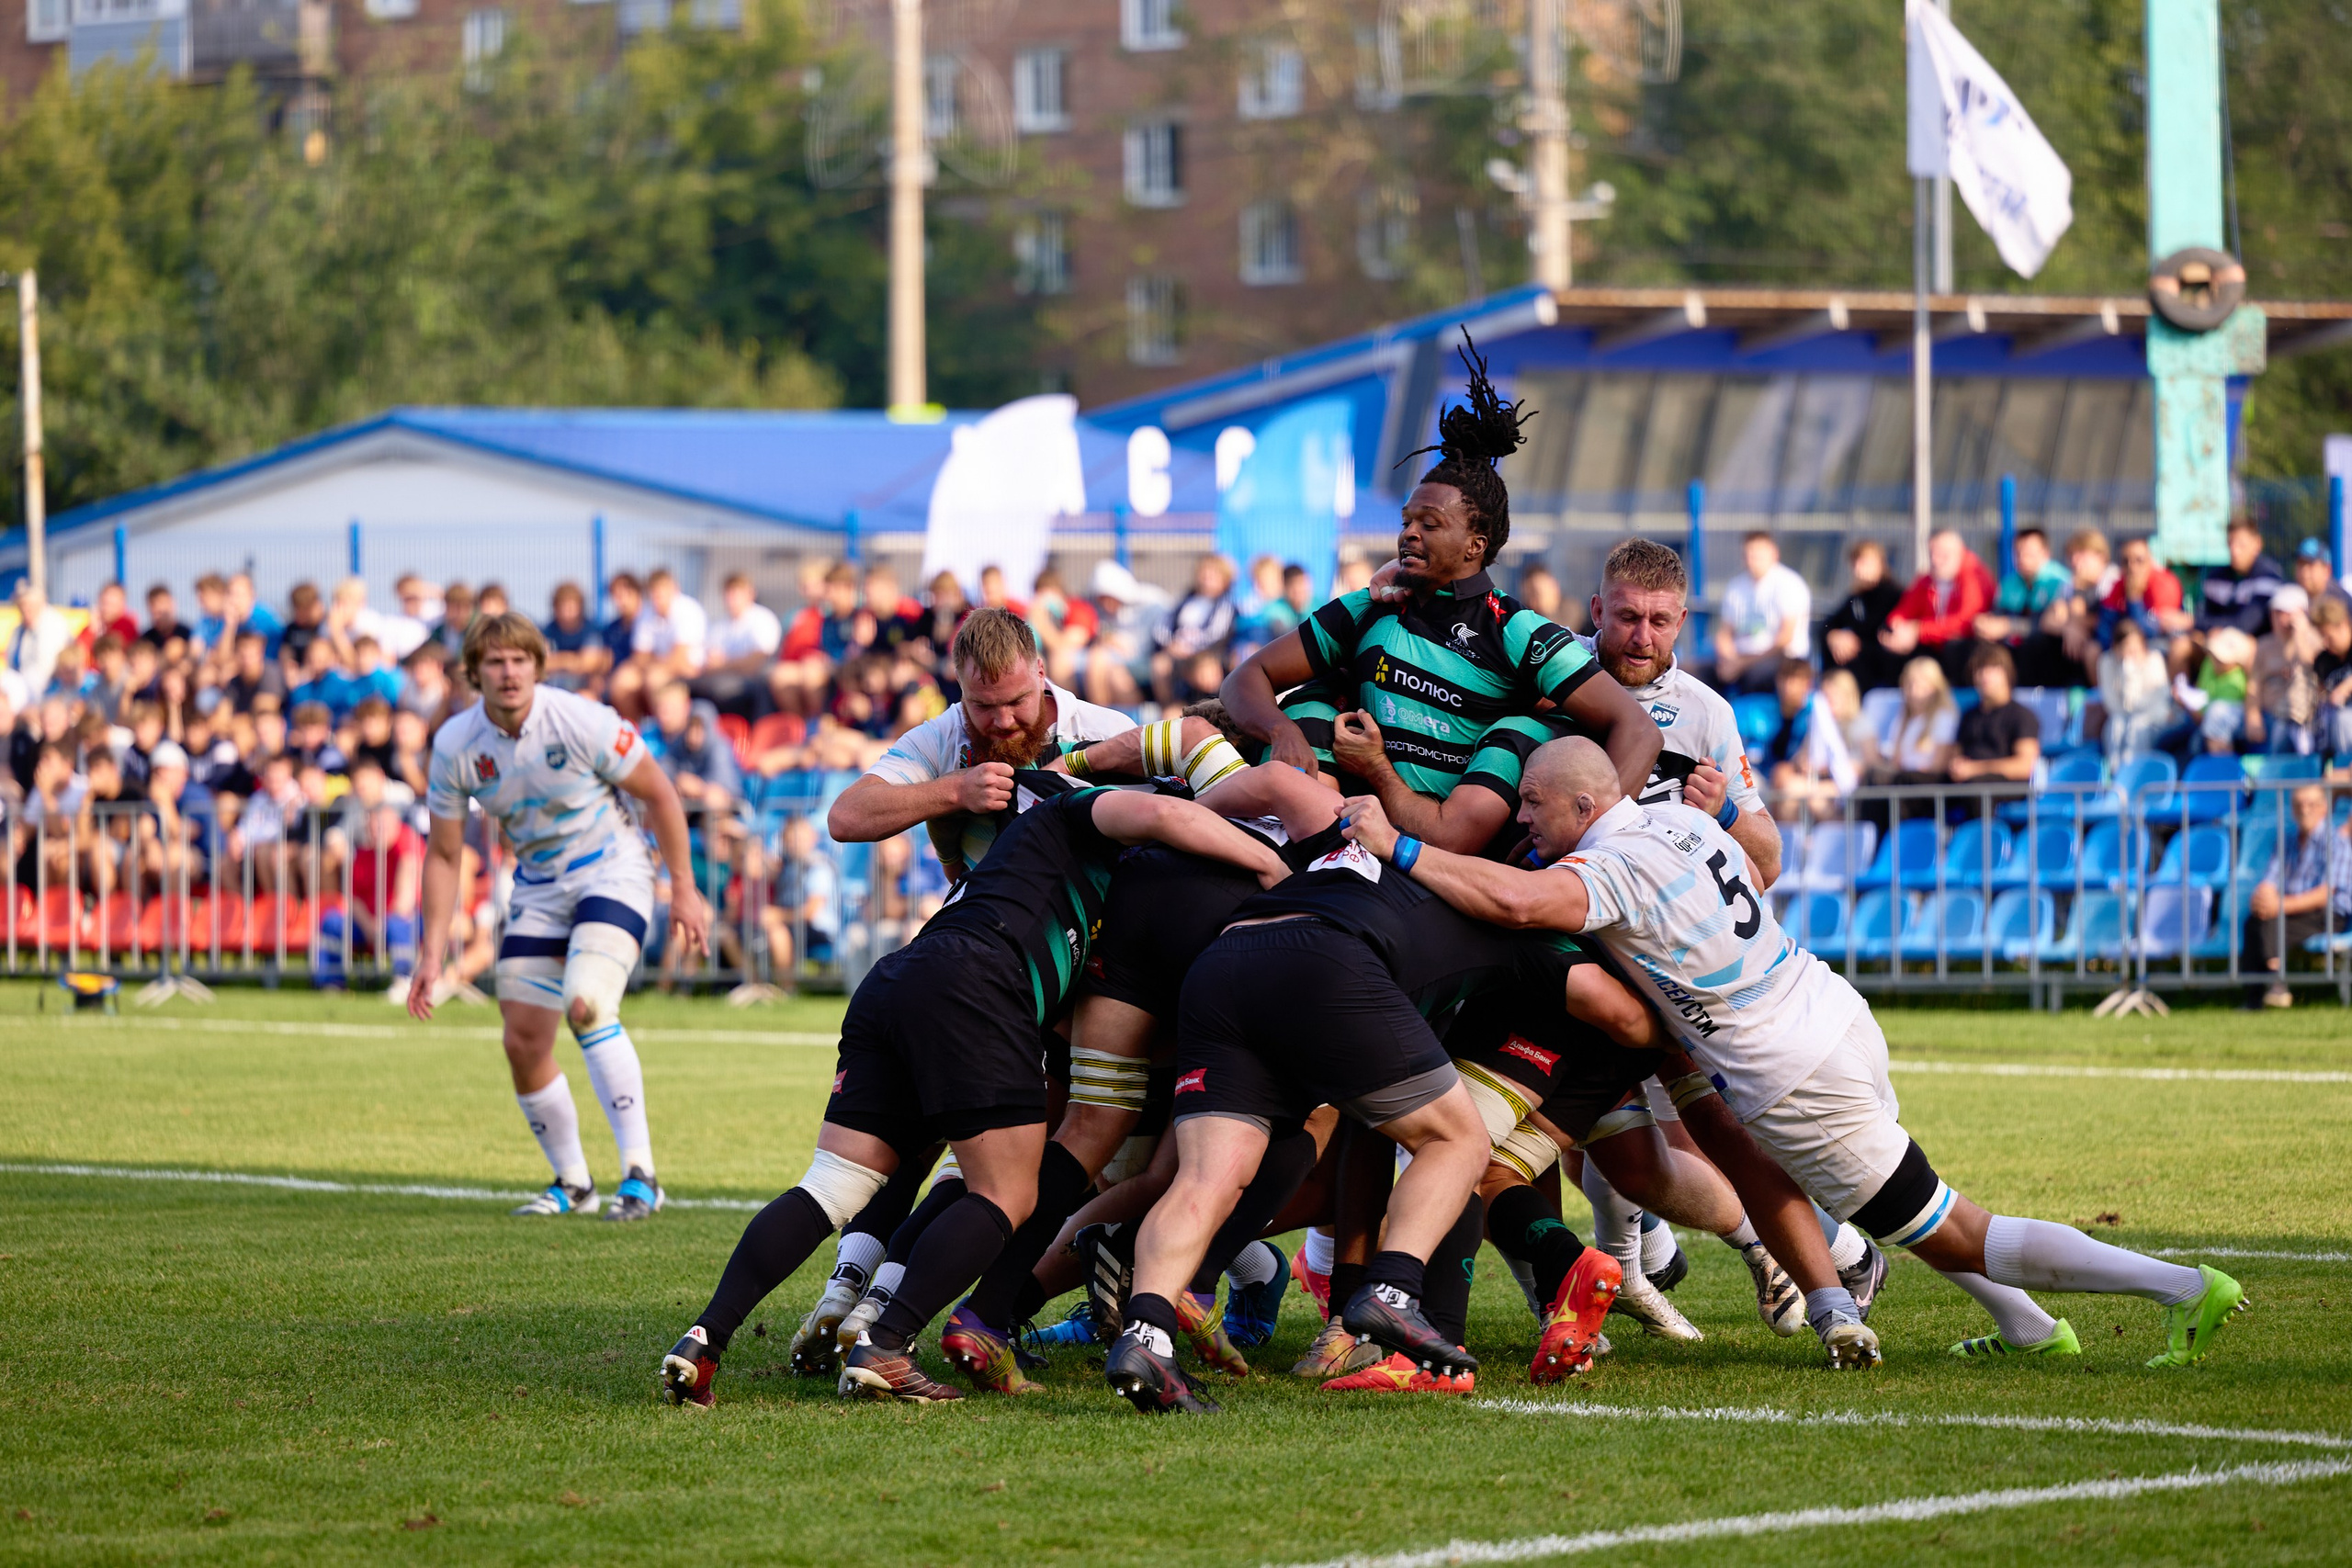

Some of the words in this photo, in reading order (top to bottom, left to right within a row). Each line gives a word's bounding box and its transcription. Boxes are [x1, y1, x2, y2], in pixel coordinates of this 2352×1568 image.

[1394, 669, 1463, 707] ПОЛЮС
[1384, 739, 1473, 764] РАСПРОМСТРОЙ
[1705, 849, 1761, 940] 5
[1508, 1040, 1534, 1056] Альфа
[1533, 1050, 1552, 1066] Банк
